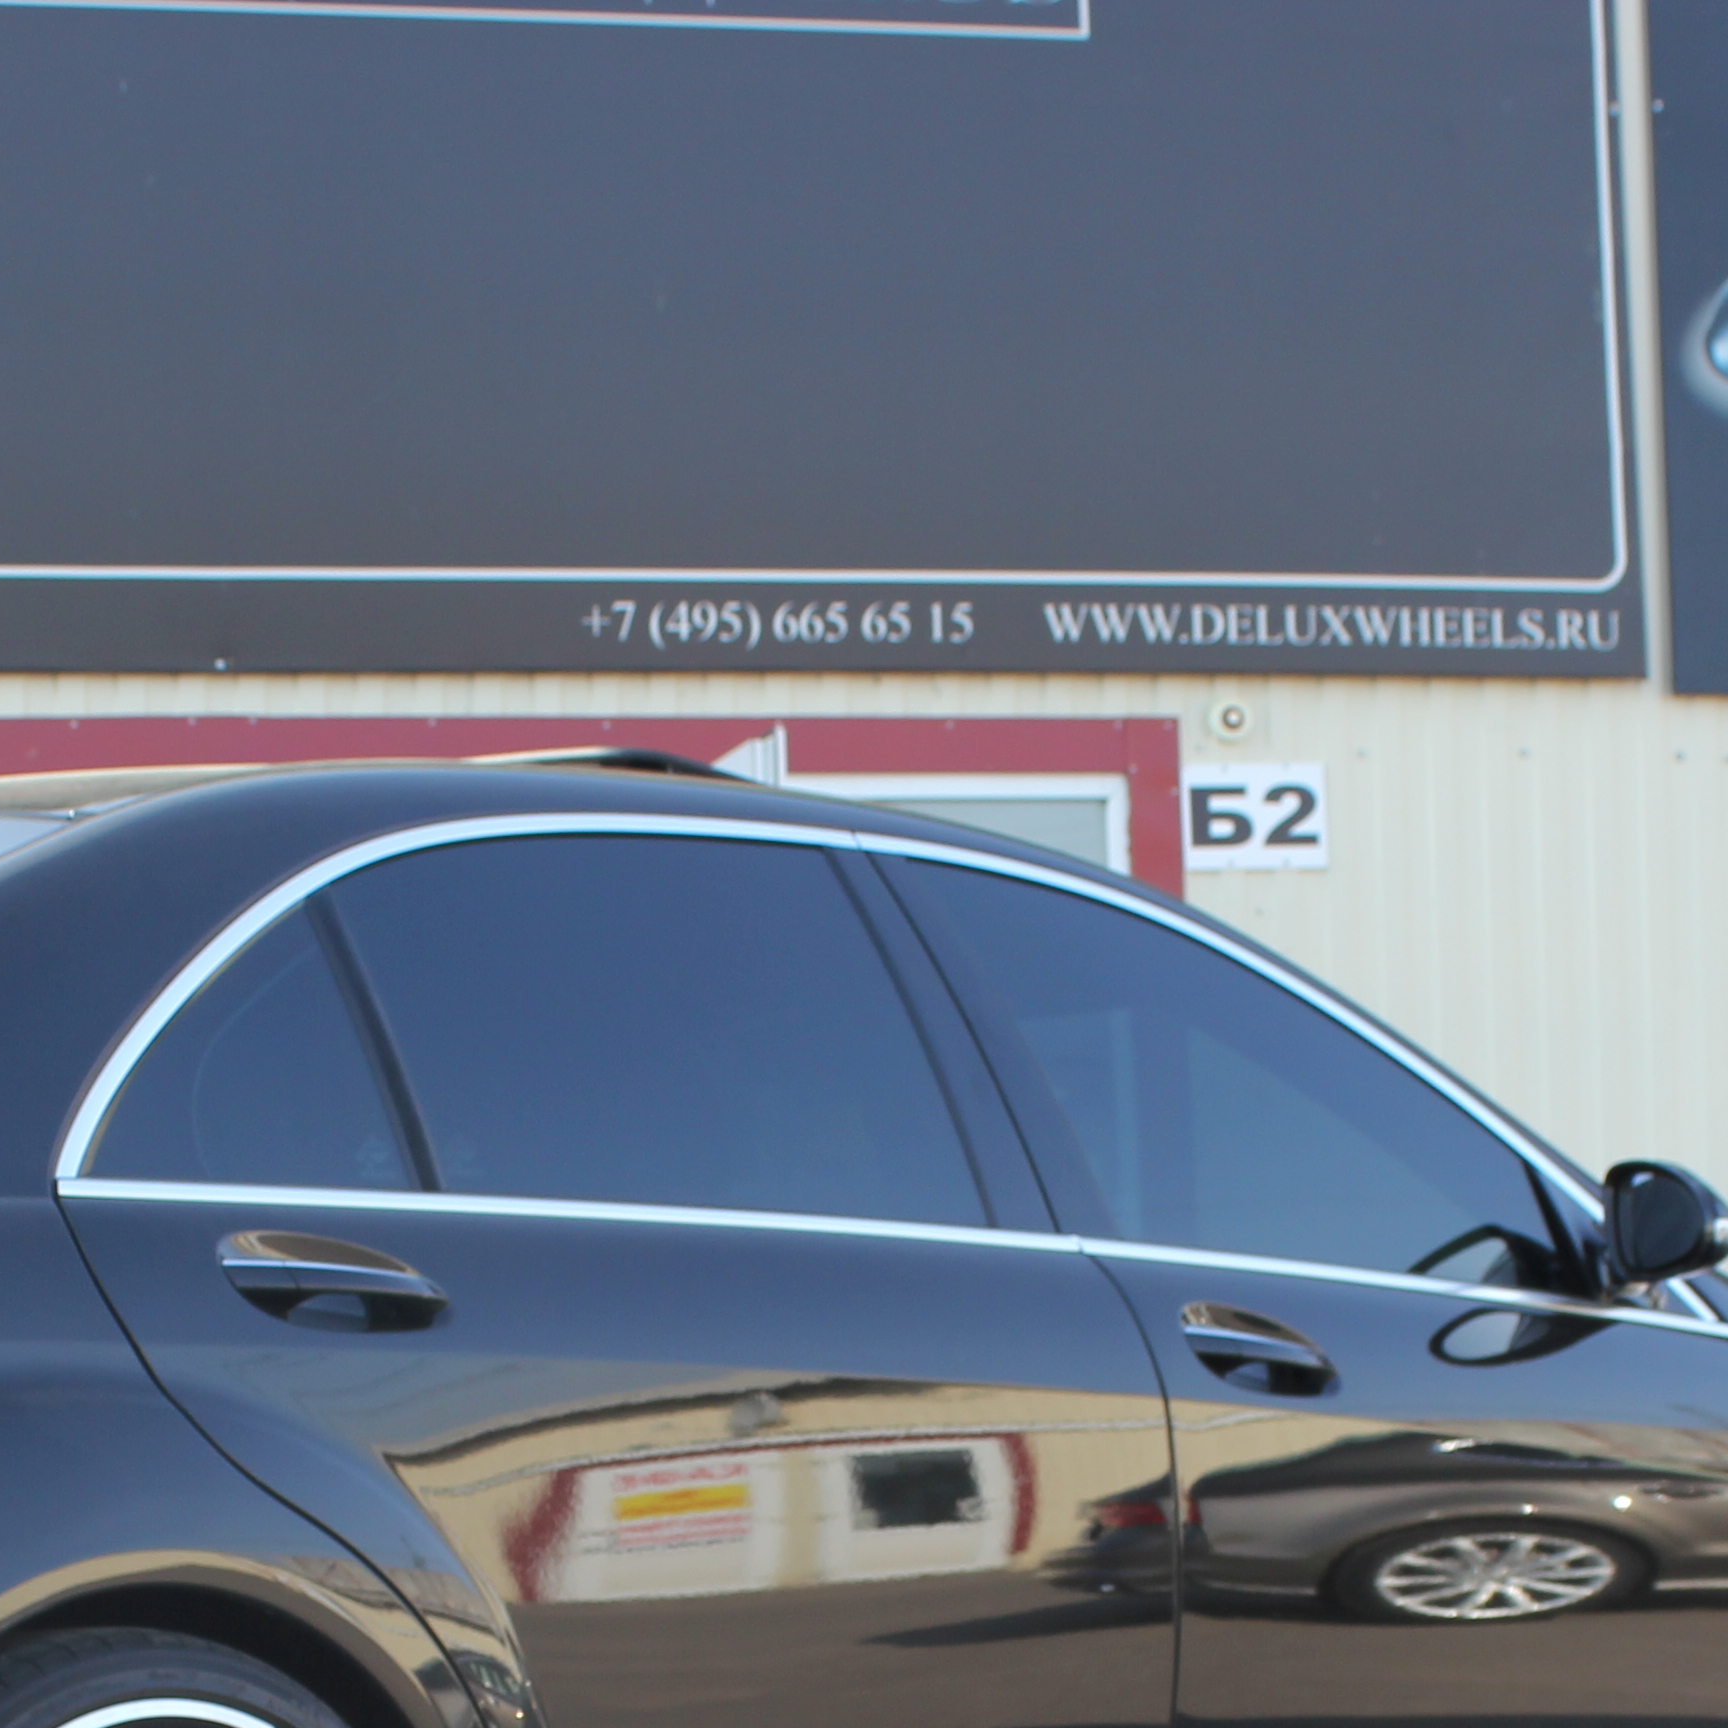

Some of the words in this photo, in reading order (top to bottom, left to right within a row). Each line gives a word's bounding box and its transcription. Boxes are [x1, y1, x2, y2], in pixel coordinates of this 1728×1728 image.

[582, 600, 636, 642] +7
[647, 600, 762, 650] (495)
[771, 600, 849, 643] 665
[859, 600, 912, 643] 65
[929, 601, 974, 643] 15
[1042, 602, 1621, 651] WWW.DELUXWHEELS.RU
[1189, 785, 1319, 846] Б2
